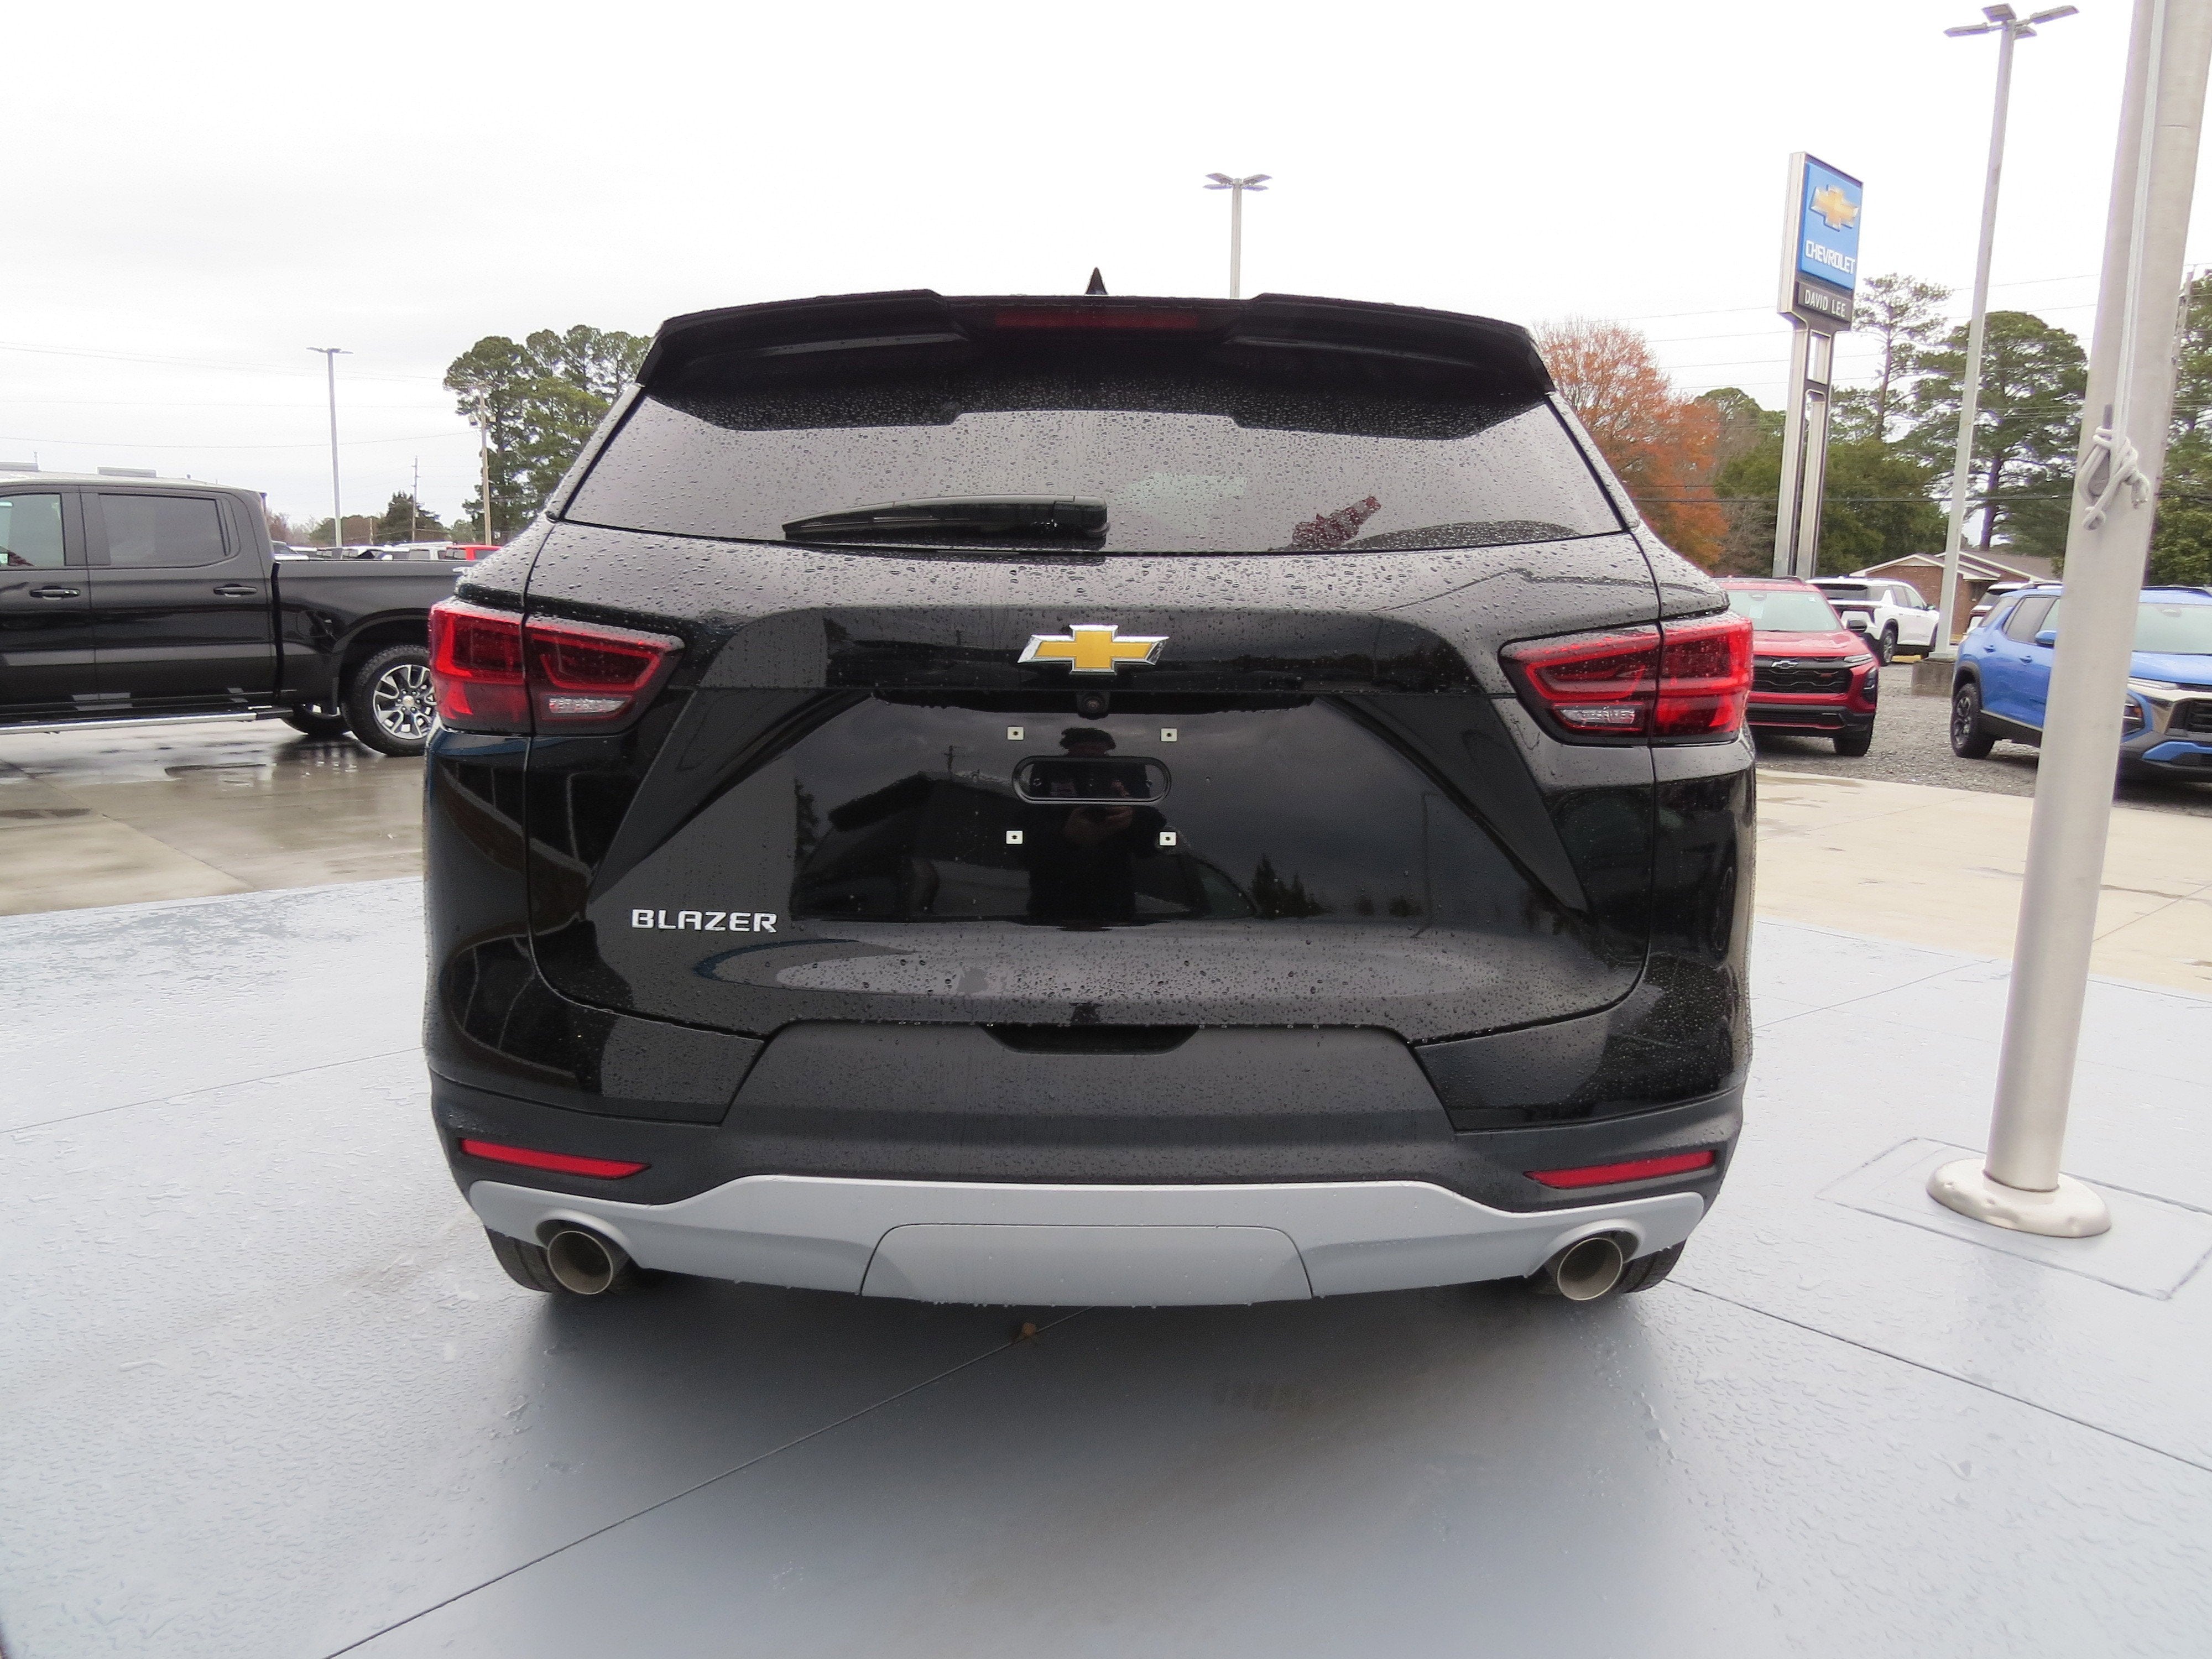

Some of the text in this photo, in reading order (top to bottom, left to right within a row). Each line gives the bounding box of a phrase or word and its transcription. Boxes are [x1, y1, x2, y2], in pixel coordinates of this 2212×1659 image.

[1806, 241, 1855, 274] CHEVROLET
[1804, 289, 1846, 317] DAVID LEE
[632, 909, 777, 933] BLAZER
